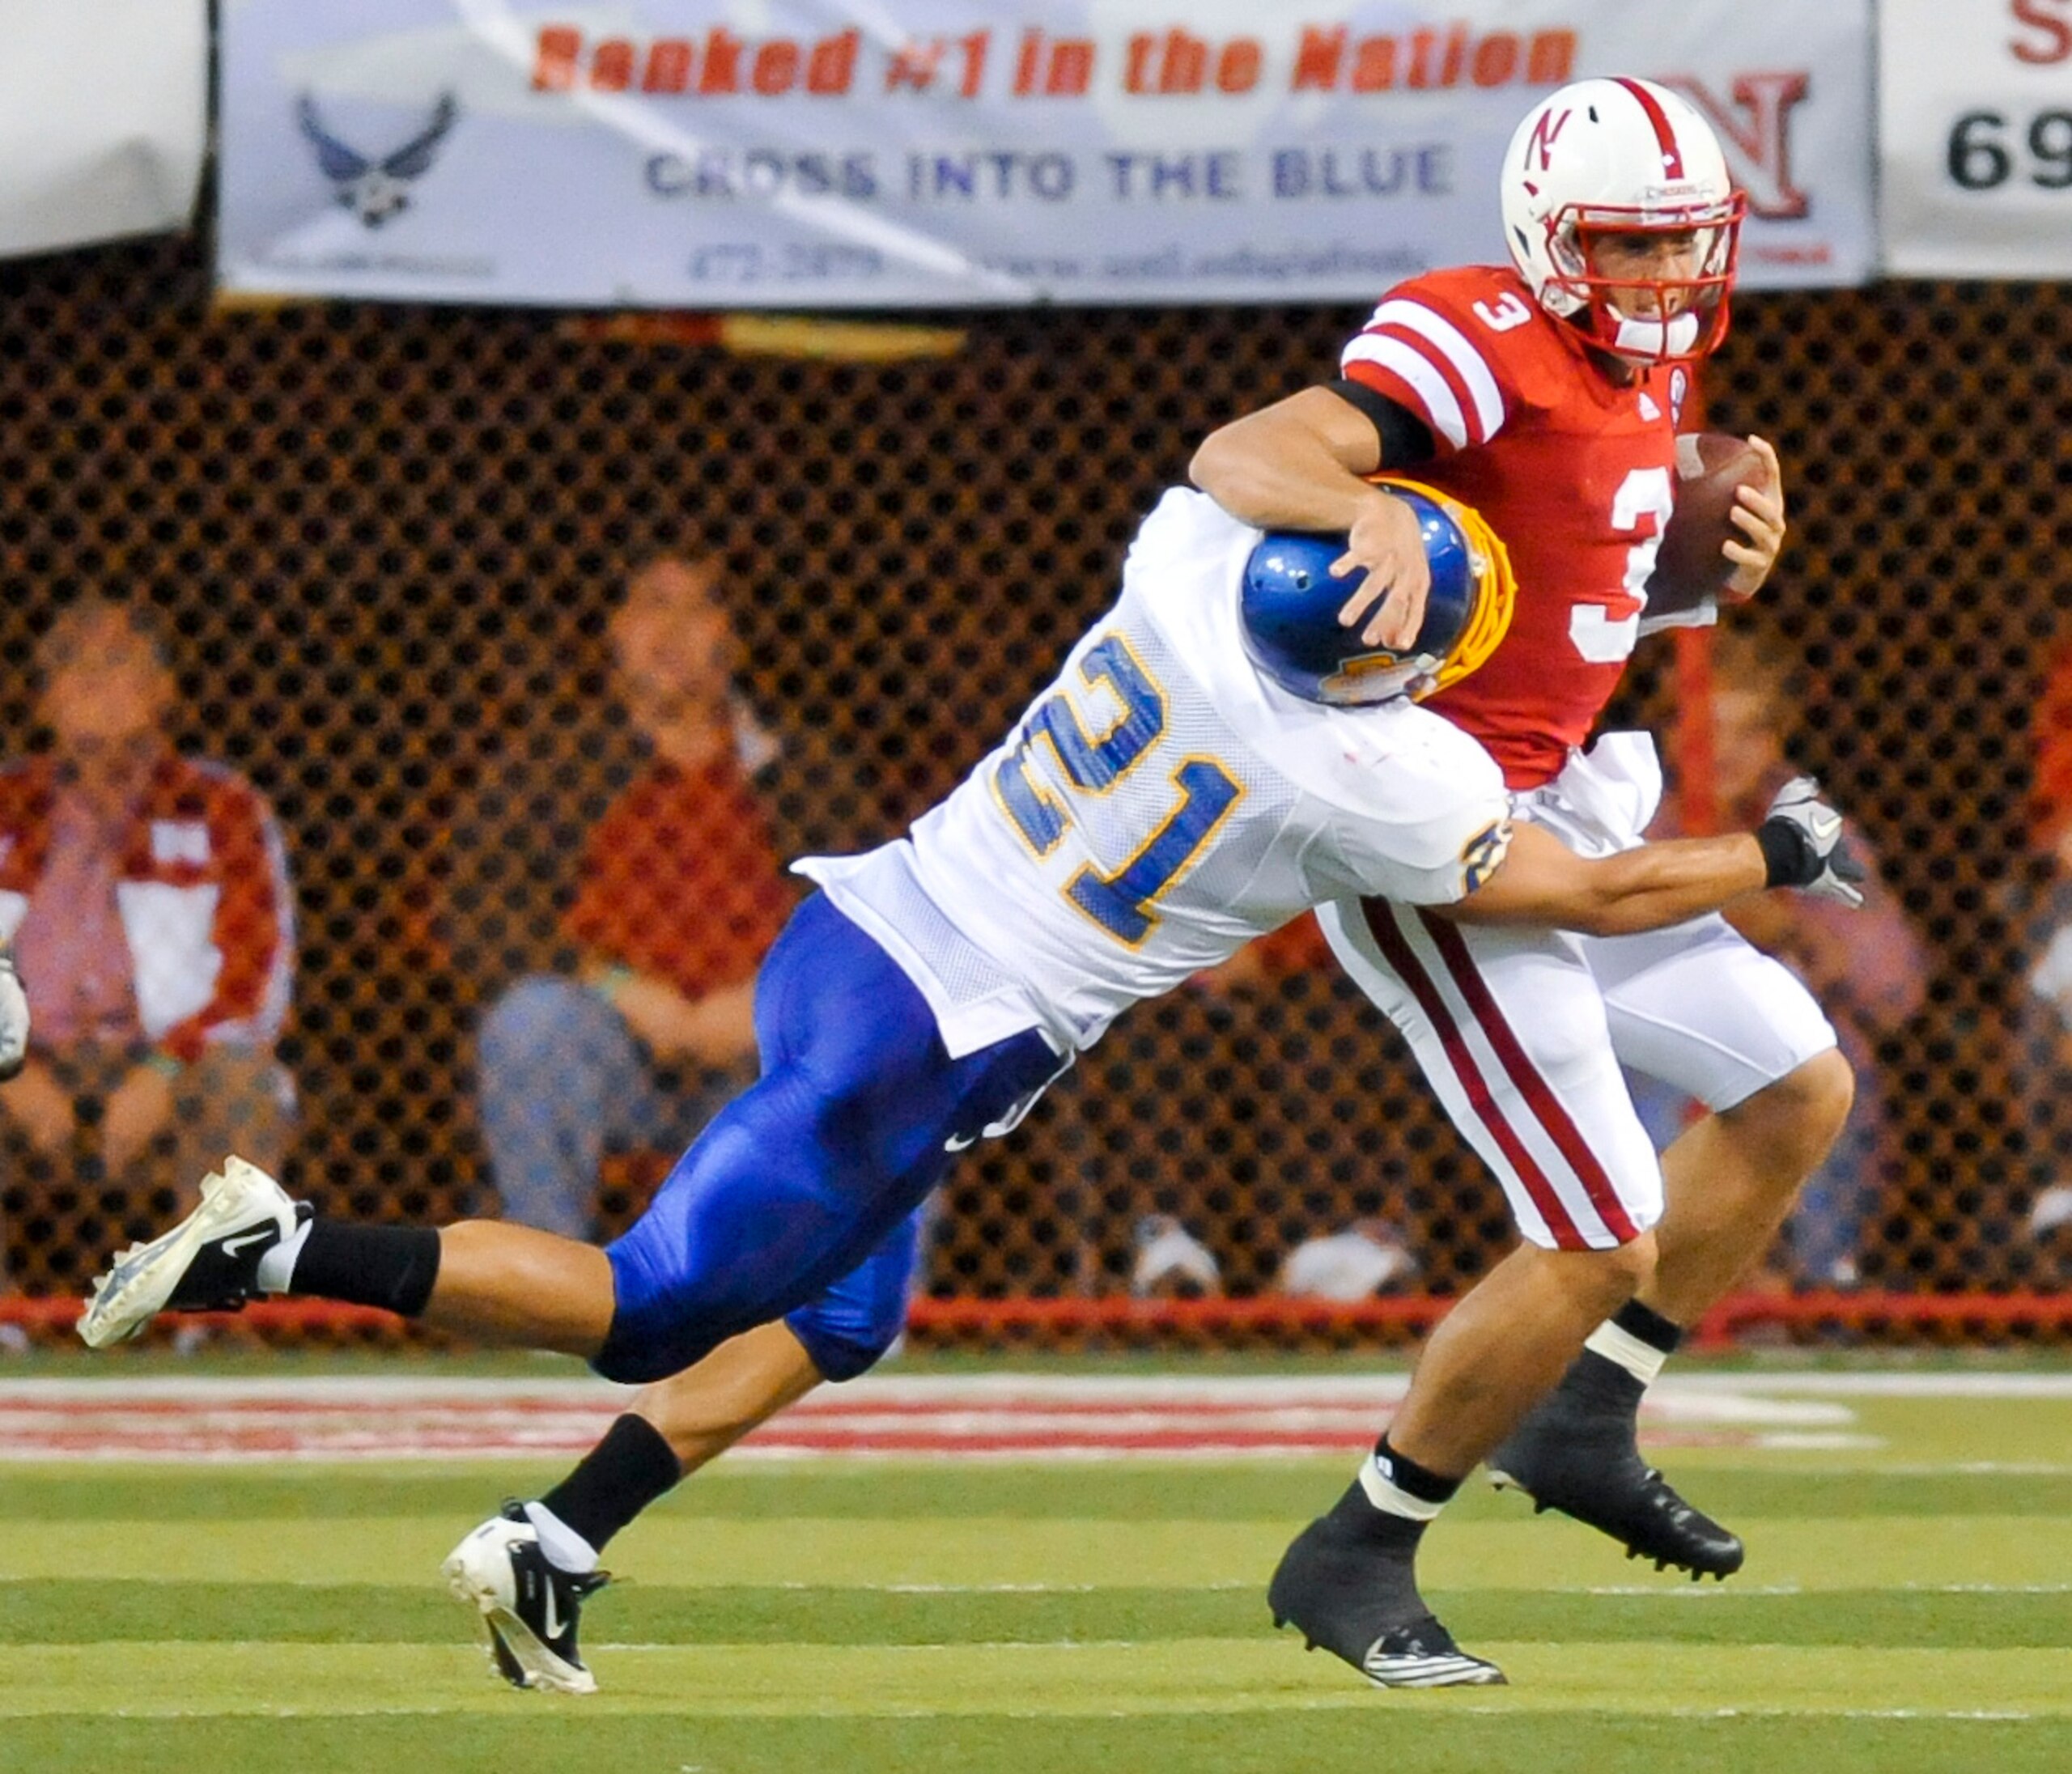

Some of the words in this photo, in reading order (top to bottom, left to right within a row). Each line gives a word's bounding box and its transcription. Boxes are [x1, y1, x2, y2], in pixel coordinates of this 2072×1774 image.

[531, 25, 860, 96] Ranked
[884, 30, 991, 97] #1
[1013, 28, 1096, 95] in
[1123, 26, 1264, 95] the
[1290, 24, 1578, 93] Nation
[644, 147, 882, 202] CROSS
[907, 150, 1076, 202] INTO
[1104, 150, 1240, 201] THE
[1271, 146, 1454, 198] BLUE
[1522, 106, 1573, 172] N
[1654, 71, 1811, 220] N
[1946, 108, 2072, 193] 69
[1473, 291, 1532, 332] 3
[1568, 465, 1675, 663] 3
[992, 630, 1247, 953] 21
